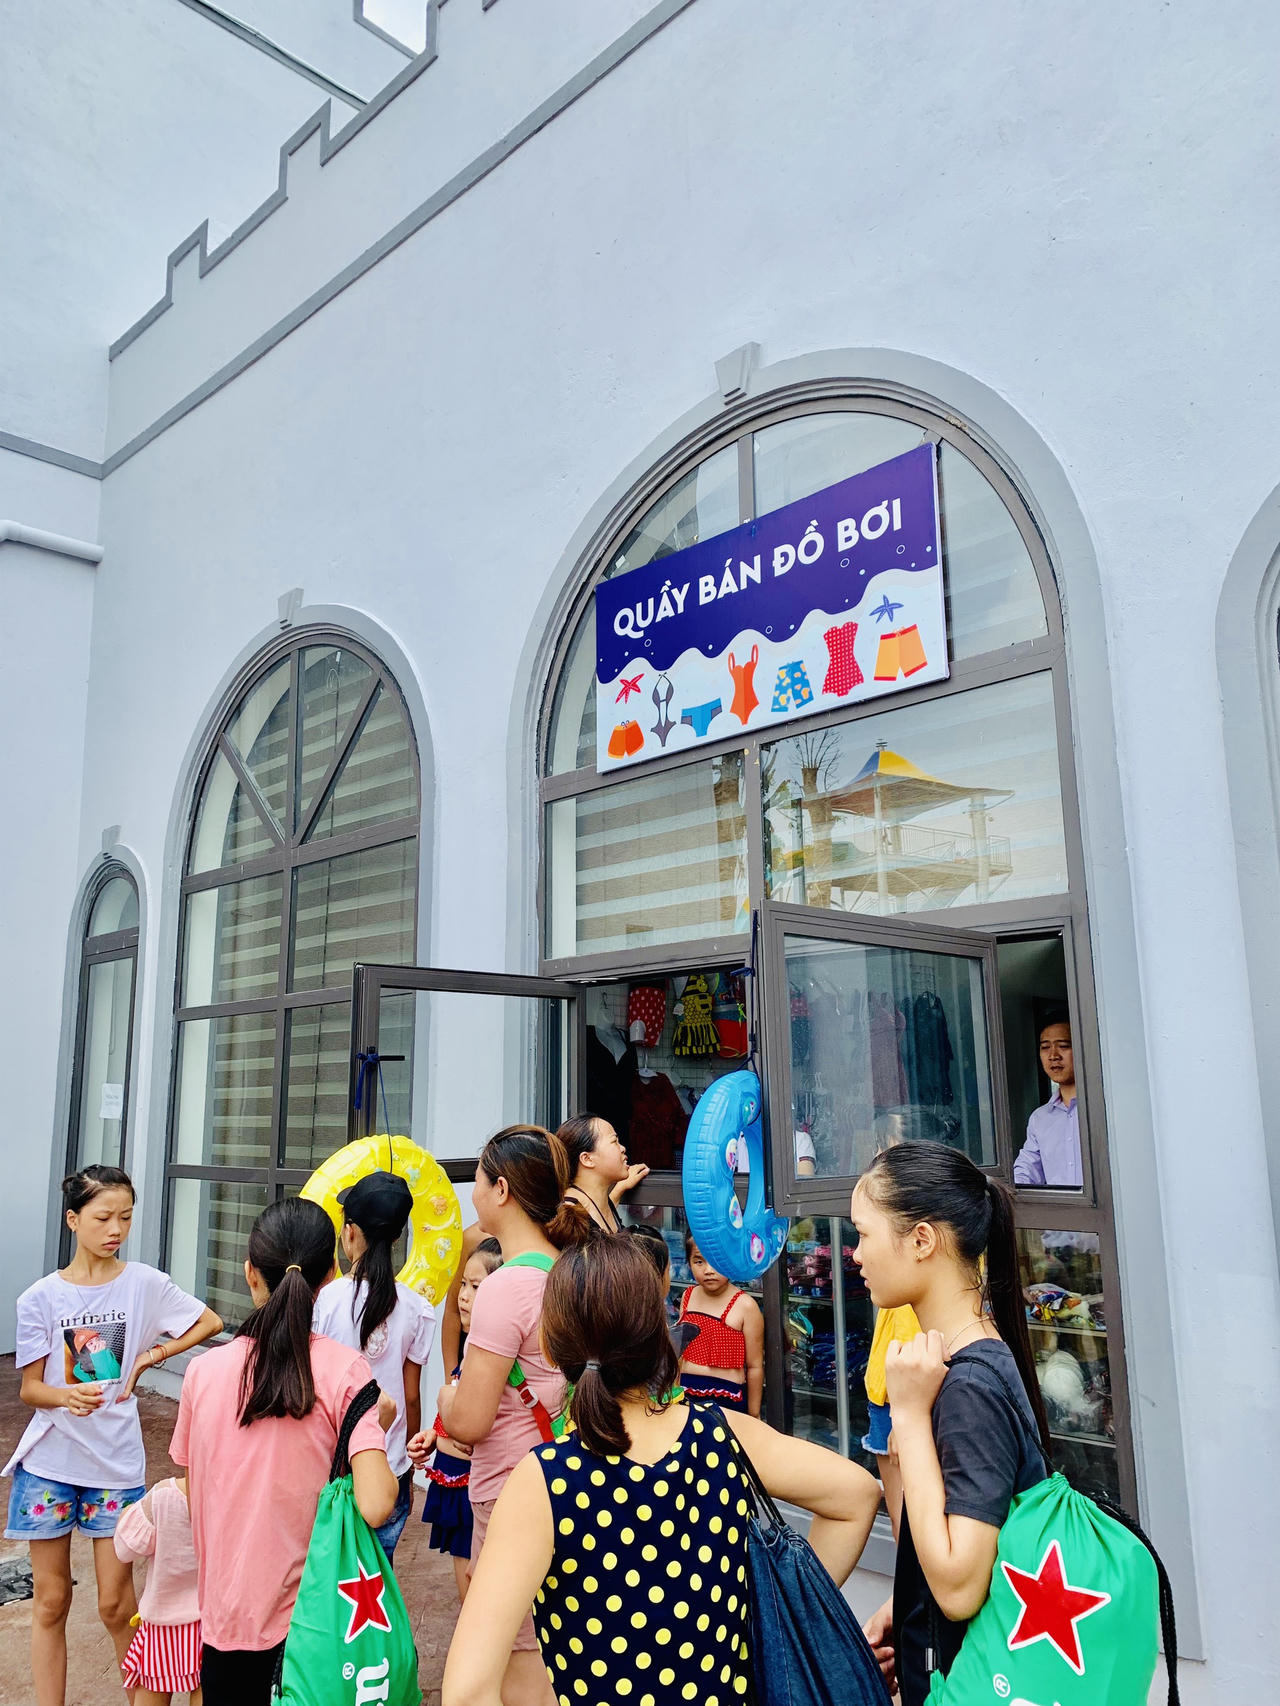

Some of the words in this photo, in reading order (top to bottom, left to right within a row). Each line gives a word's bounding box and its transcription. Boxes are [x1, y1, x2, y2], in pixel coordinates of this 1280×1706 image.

[613, 580, 691, 638] QUẦY
[699, 554, 761, 606] BÁN
[772, 519, 825, 577] ĐỒ
[837, 497, 901, 552] BƠI
